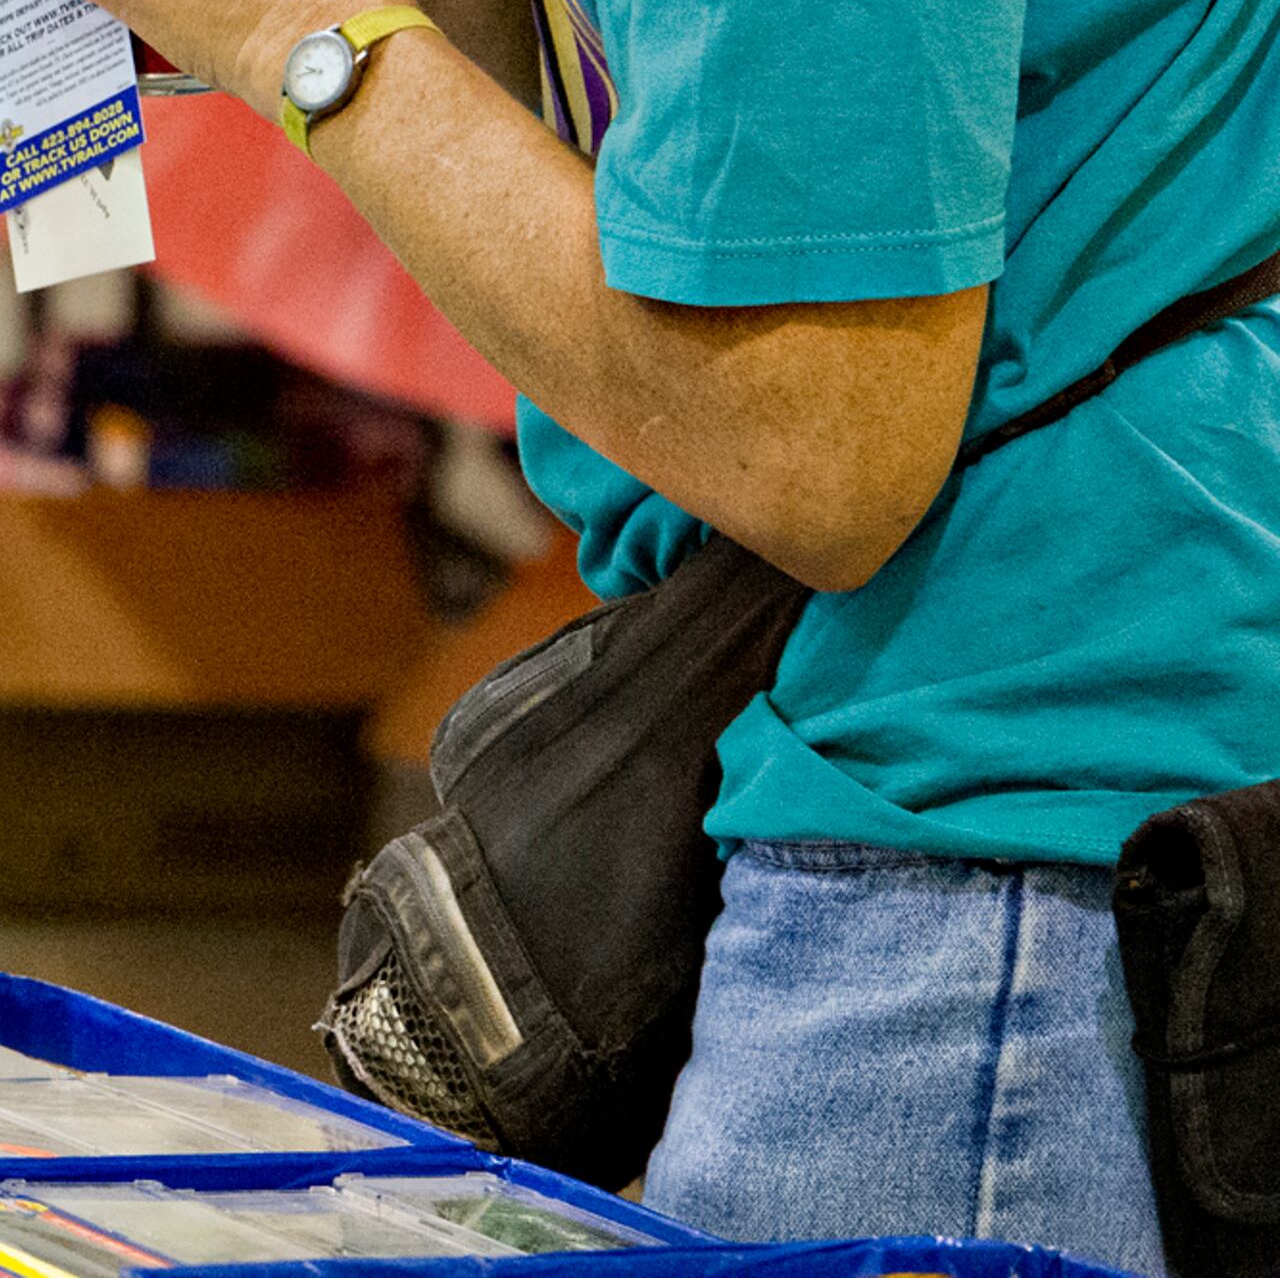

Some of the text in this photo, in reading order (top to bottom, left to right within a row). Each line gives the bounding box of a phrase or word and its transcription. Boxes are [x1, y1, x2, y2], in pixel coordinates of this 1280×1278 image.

[7, 39, 25, 55] ALL
[25, 27, 46, 46] TRIP
[46, 12, 75, 35] DATES
[13, 20, 34, 39] OUT
[0, 111, 133, 186] OR TRACK US DOWN
[0, 185, 17, 203] AT
[18, 123, 140, 193] WWW.TVRAIL.COM
[6, 145, 39, 169] CALL
[42, 100, 124, 151] 423.894.8028
